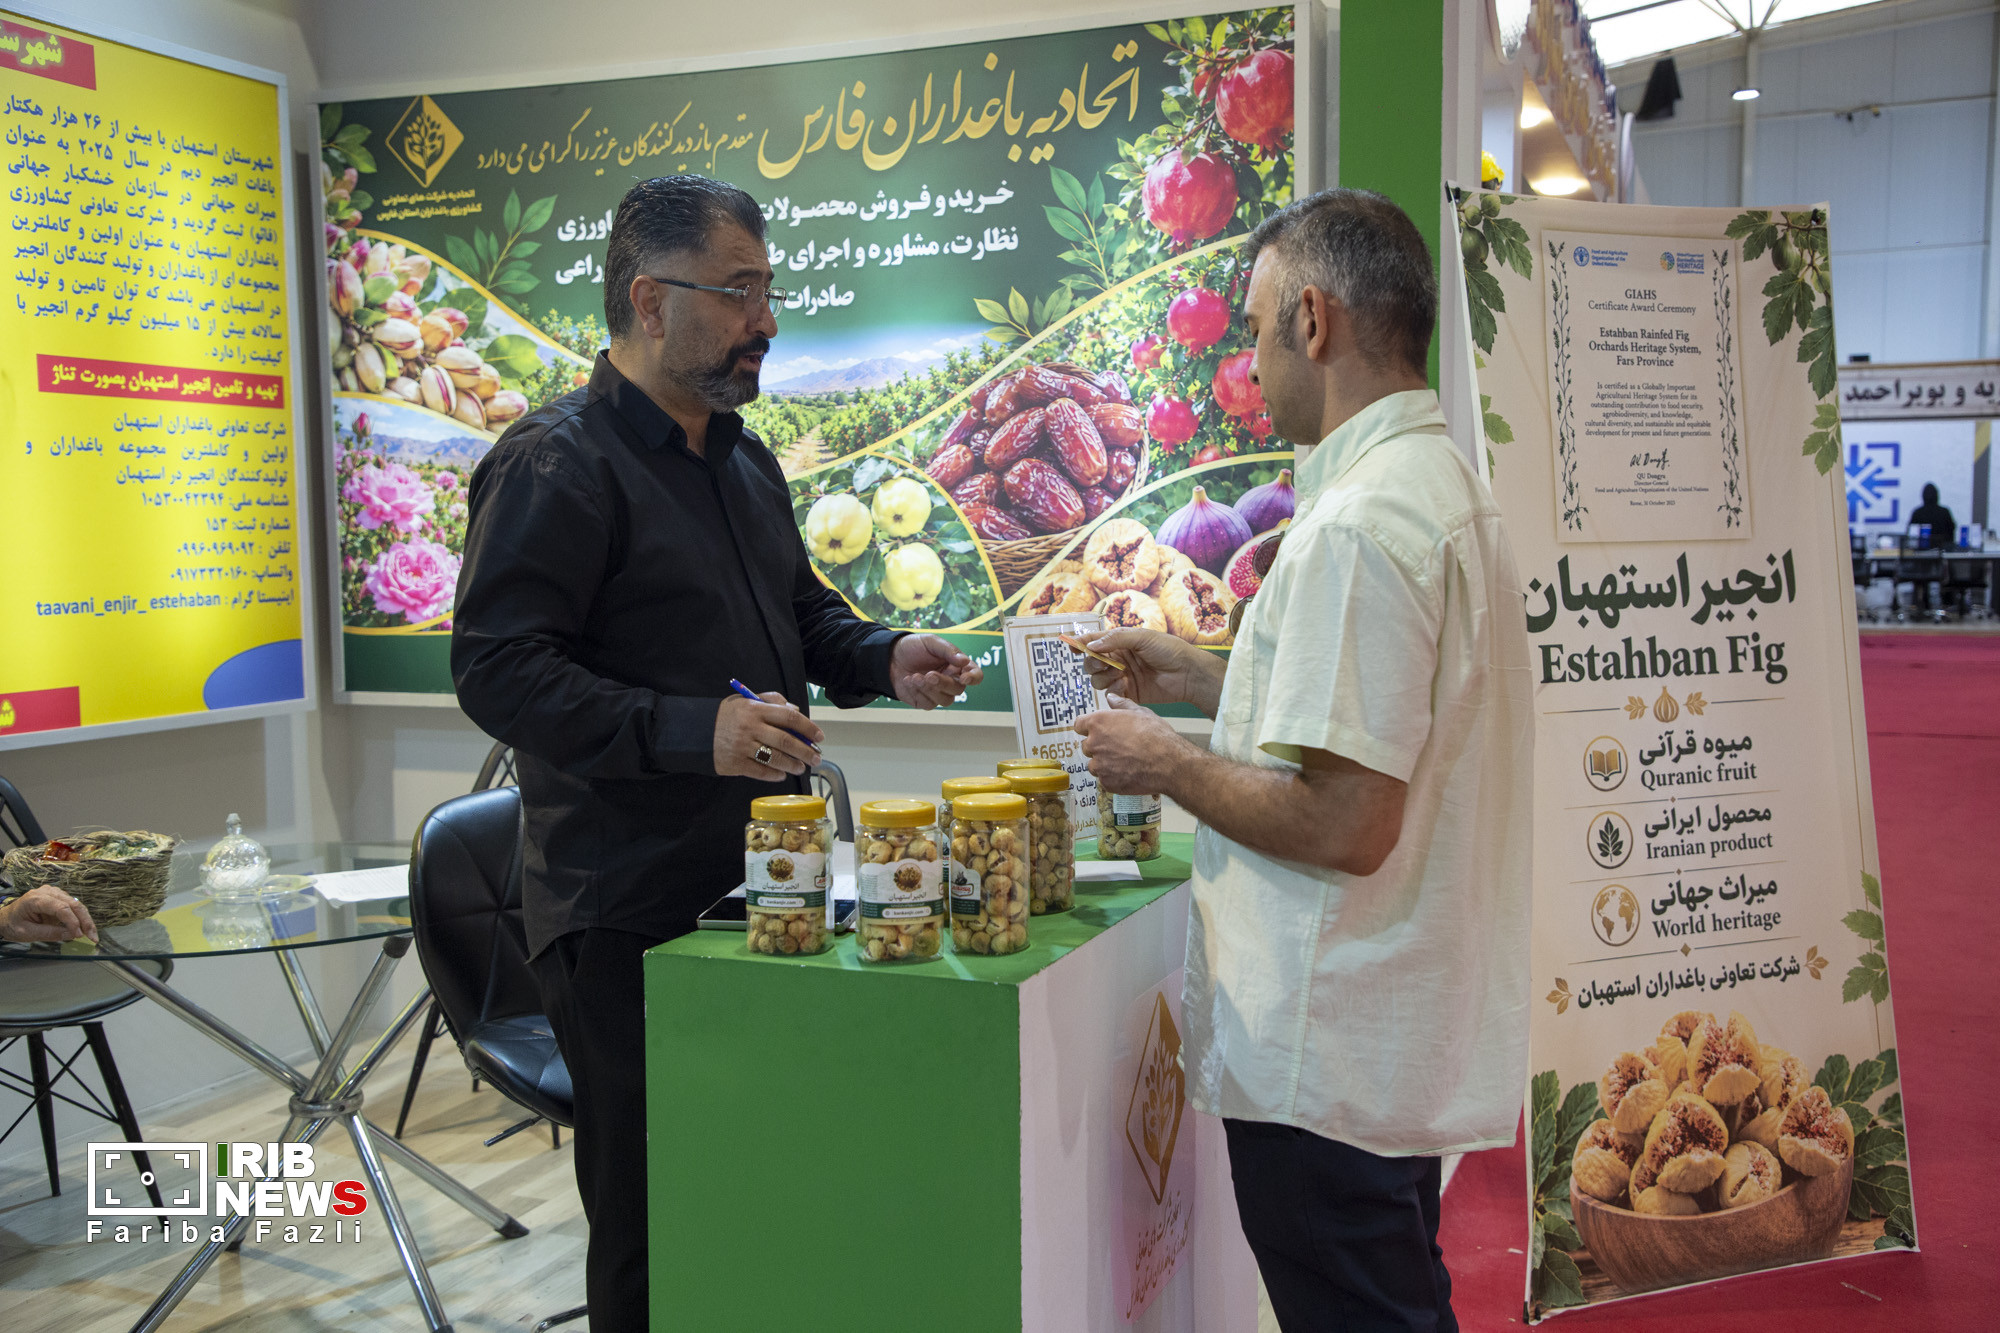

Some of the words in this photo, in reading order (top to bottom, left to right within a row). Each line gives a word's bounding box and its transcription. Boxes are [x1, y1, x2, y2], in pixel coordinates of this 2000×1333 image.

[3, 94, 43, 116] هکتار
[862, 52, 1025, 171] باغداران
[1026, 40, 1140, 164] اتحادیه
[50, 105, 78, 128] هزار
[84, 112, 101, 130] ۲۶
[6, 124, 46, 147] عنوان
[109, 119, 119, 138] از
[125, 124, 152, 146] بیش
[157, 129, 166, 149] با
[758, 80, 867, 179] فارس
[57, 138, 69, 155] به
[79, 138, 113, 160] ۲۰۲۵
[171, 135, 218, 158] استهبان
[589, 127, 619, 177] عزیز
[712, 113, 754, 176] مقدم
[7, 154, 51, 178] جهانی
[123, 149, 149, 169] سال
[158, 161, 172, 176] در
[223, 147, 274, 172] شهرستان
[62, 163, 114, 186] خشکبار
[181, 168, 202, 181] دیم
[210, 173, 238, 189] انجیر
[9, 186, 73, 206] کشاورزی
[125, 177, 169, 199] سازمان
[179, 191, 192, 205] در
[245, 177, 276, 199] باغات
[948, 180, 1015, 214] خرید
[79, 196, 119, 217] تعاونی
[201, 193, 236, 215] جهانی
[244, 201, 277, 222] میراث
[860, 184, 931, 221] فروش
[933, 192, 947, 216] و
[11, 214, 72, 233] کاملترین
[125, 204, 165, 226] شرکت
[171, 217, 178, 230] و
[78, 226, 85, 240] و
[91, 225, 124, 246] اولین
[183, 217, 217, 236] گردید
[222, 223, 244, 240] ثبت
[128, 230, 163, 251] عنوان
[170, 240, 181, 256] به
[186, 240, 232, 261] استهبان
[868, 232, 940, 267] مشاوره
[235, 248, 279, 271] باغداران
[788, 237, 851, 271] اجرای
[853, 247, 866, 268] و
[784, 283, 855, 315] صادرات
[1624, 289, 1657, 300] GIAHS
[1588, 300, 1628, 311] Certificate
[1630, 302, 1655, 312] Award
[1657, 304, 1696, 315] Ceremony
[1600, 327, 1638, 338] Estahban
[1640, 328, 1673, 339] Rainfed
[1676, 330, 1690, 342] Fig
[1589, 341, 1628, 352] Orchards
[1631, 342, 1667, 355] Heritage
[1669, 343, 1701, 355] System,
[1616, 355, 1634, 366] Fars
[1637, 356, 1674, 367] Province
[51, 363, 77, 385] تناژ
[79, 369, 126, 389] بصورت
[128, 370, 179, 392] استهبان
[180, 376, 211, 396] انجیر
[212, 378, 244, 398] تامین
[246, 386, 254, 400] و
[254, 383, 279, 401] تهیه
[1596, 392, 1631, 400] Agricultural
[1633, 393, 1657, 401] Heritage
[1659, 393, 1679, 401] System
[1604, 382, 1628, 390] certified
[1641, 383, 1665, 392] Globally
[1667, 384, 1695, 392] Important
[1591, 402, 1623, 410] outstanding
[255, 493, 290, 506] شناسه
[259, 517, 291, 535] شماره
[1523, 551, 1691, 633] استهبان
[1691, 548, 1797, 625] انجیر
[969, 645, 1003, 668] آدر
[1538, 635, 1720, 684] Estahban
[1726, 632, 1788, 684] Fig
[1639, 729, 1697, 765] قرآنی
[1703, 735, 1752, 760] میوه
[1640, 764, 1713, 791] Quranic
[1717, 762, 1757, 783] fruit
[1644, 806, 1702, 838] ایرانی
[1707, 804, 1772, 832] محصول
[1646, 839, 1706, 860] Iranian
[1710, 833, 1773, 858] product
[1651, 880, 1713, 915] جهانی
[1719, 874, 1778, 904] میراث
[1652, 915, 1705, 938] World
[1712, 911, 1781, 934] heritage
[1710, 963, 1755, 990] تعاونی
[1760, 956, 1800, 982] شرکت
[1578, 975, 1641, 1008] استهبان
[1646, 967, 1705, 998] باغداران
